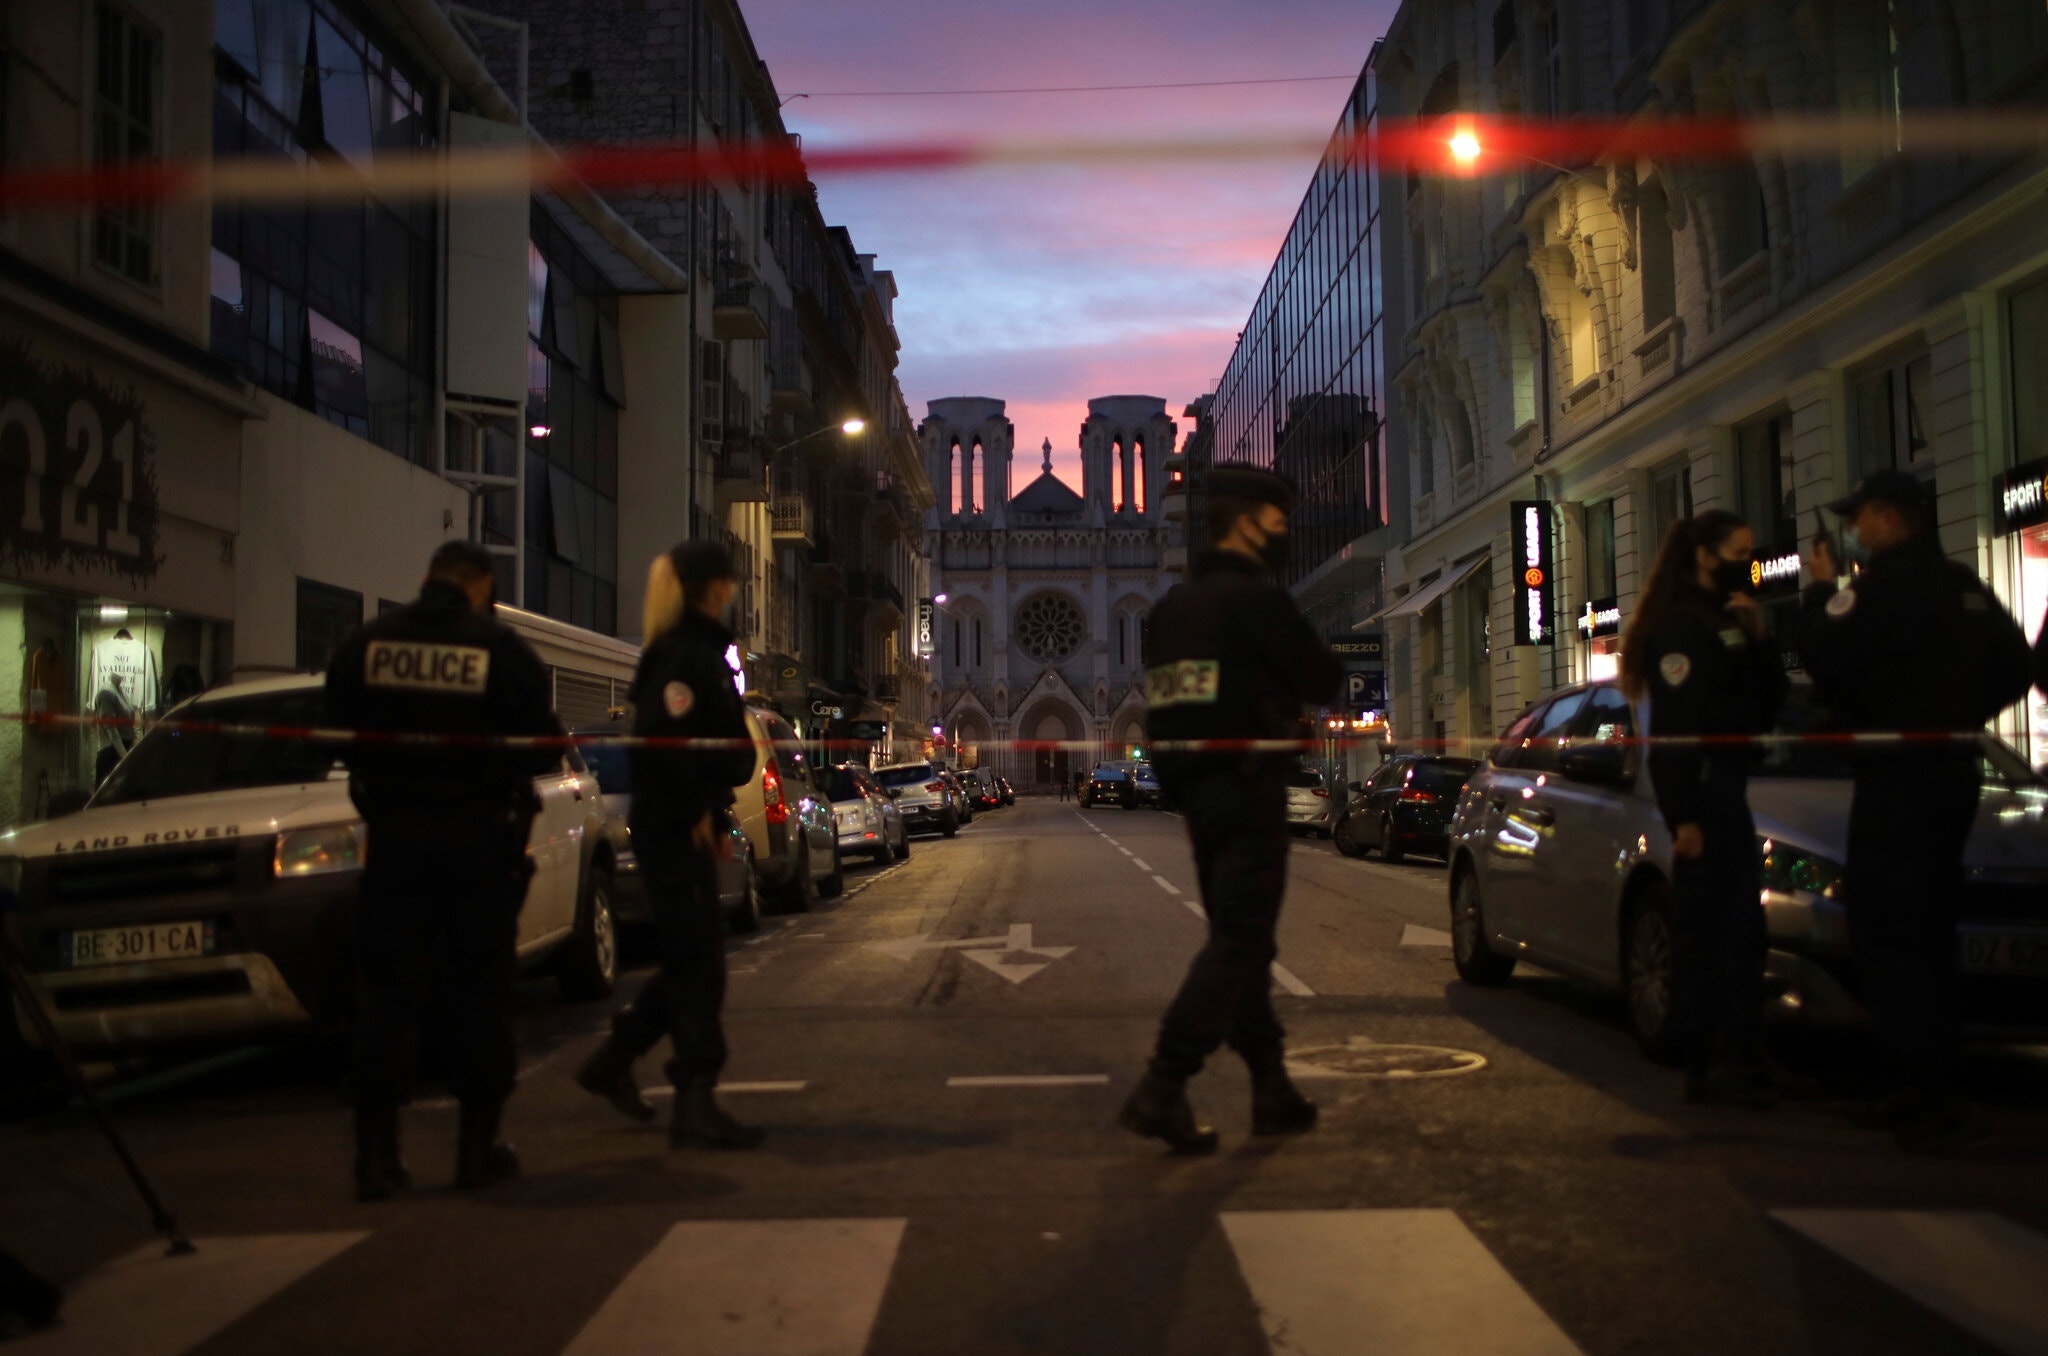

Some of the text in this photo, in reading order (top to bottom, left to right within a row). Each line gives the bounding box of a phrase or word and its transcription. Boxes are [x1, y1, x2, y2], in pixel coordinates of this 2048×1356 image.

[2003, 481, 2042, 511] SPORT
[1761, 554, 1801, 577] LEADER
[921, 605, 933, 642] fnac
[1594, 608, 1621, 624] LEADER
[372, 648, 480, 685] POLICE
[1349, 677, 1365, 700] P
[55, 825, 240, 852] LAND ROVER
[77, 926, 198, 961] BE-301-CA
